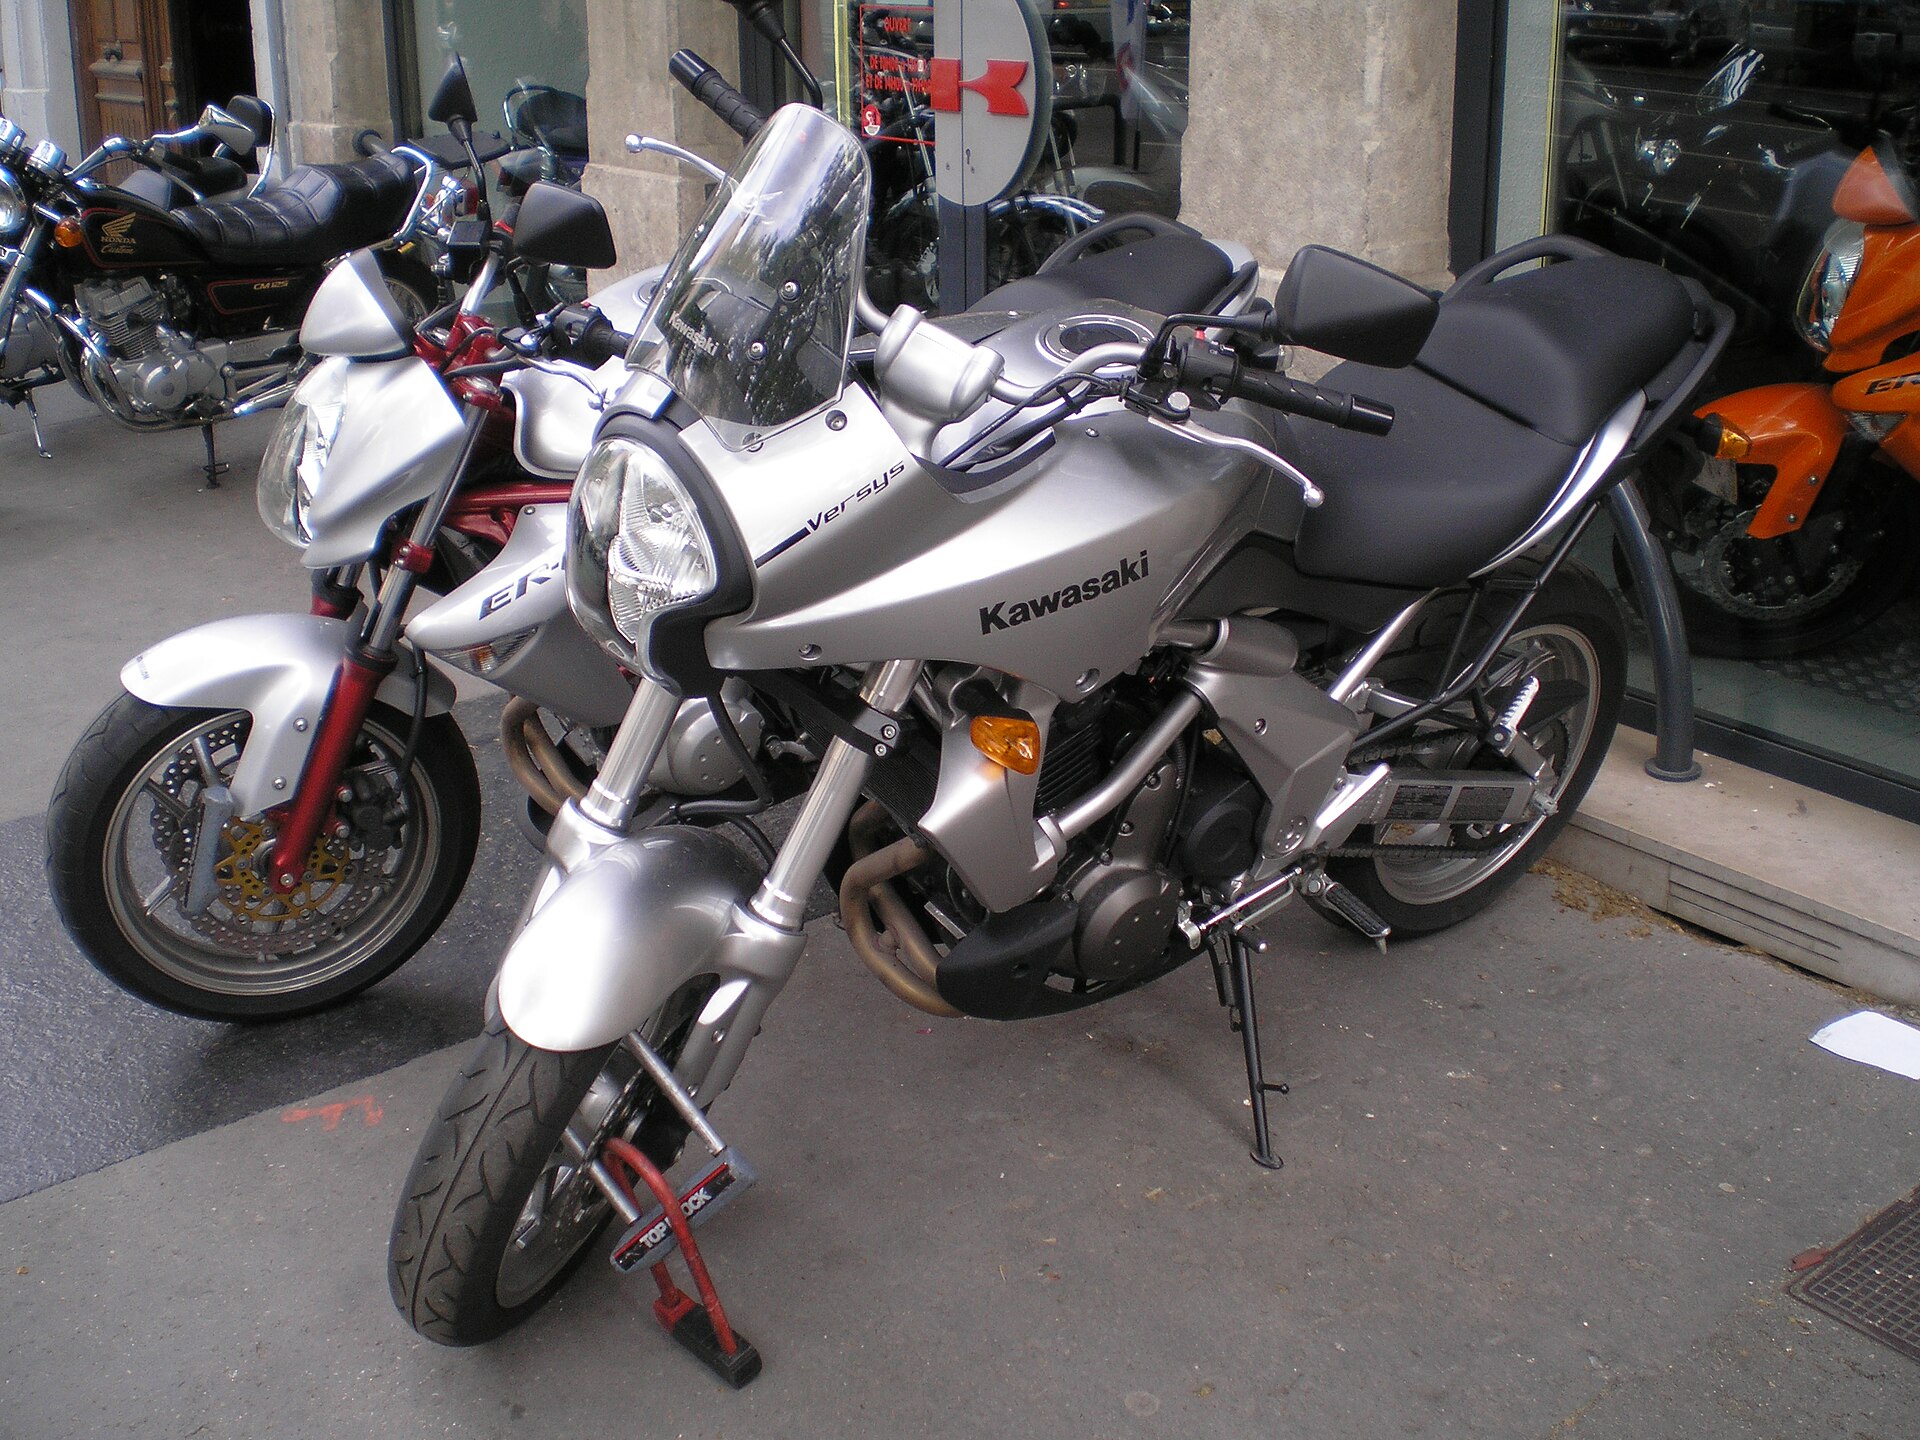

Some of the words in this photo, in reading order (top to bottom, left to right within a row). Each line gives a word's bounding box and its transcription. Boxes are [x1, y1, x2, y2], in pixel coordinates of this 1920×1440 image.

[883, 16, 913, 33] OUVERT
[869, 54, 879, 70] DE
[874, 74, 883, 90] DE
[100, 236, 136, 244] HONDA
[668, 310, 720, 357] Kawasaki
[807, 460, 905, 532] Versys
[978, 549, 1149, 636] Kawasaki
[639, 1220, 669, 1249] TOP
